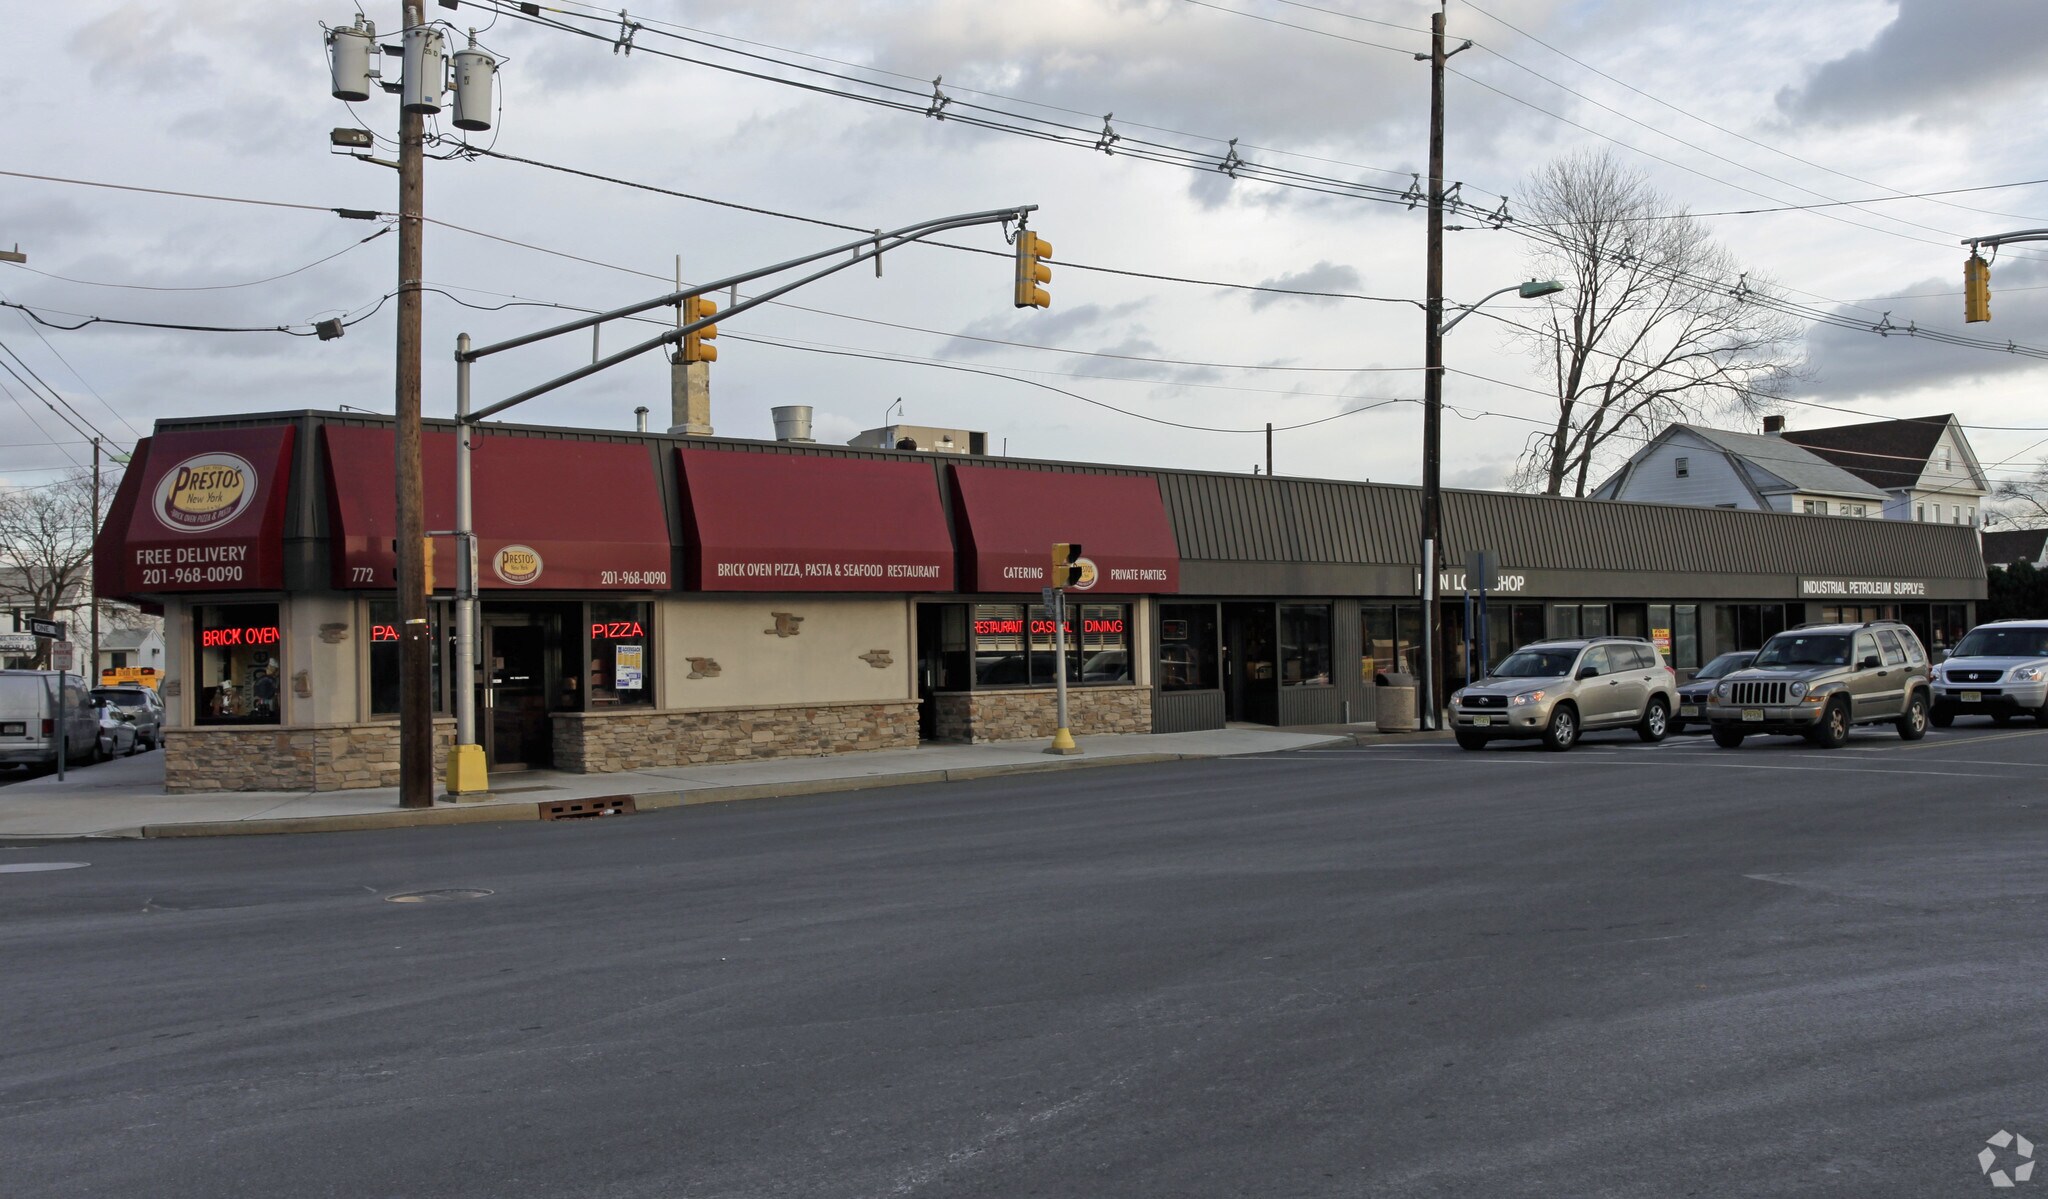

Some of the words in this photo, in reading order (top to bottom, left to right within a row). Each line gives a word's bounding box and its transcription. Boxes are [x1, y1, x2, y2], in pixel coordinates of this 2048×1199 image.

[187, 493, 204, 504] New
[207, 491, 222, 503] York
[136, 549, 172, 565] FREE
[176, 545, 247, 563] DELIVERY
[142, 565, 243, 585] 201-968-0090
[352, 567, 374, 582] 772
[601, 570, 667, 585] 201-968-0090
[717, 563, 745, 577] BRICK
[747, 563, 772, 577] OVEN
[774, 563, 803, 579] PIZZA,
[805, 563, 832, 577] PASTA
[834, 563, 842, 577] &
[843, 563, 883, 577] SEAFOOD
[887, 564, 940, 578] RESTAURANT
[1003, 566, 1044, 579] CATERING
[1110, 568, 1139, 581] PRIVATE
[1140, 569, 1167, 581] PARTIES
[1803, 580, 1847, 594] INDUSTRIAL
[1849, 581, 1892, 595] PETROLEUM
[1893, 582, 1918, 595] SUPPLY
[592, 621, 644, 639] PIZZA
[974, 620, 1023, 634] RESTAURANT
[1084, 619, 1123, 633] DINING
[203, 628, 242, 647] BRICK
[245, 627, 280, 644] OVEN
